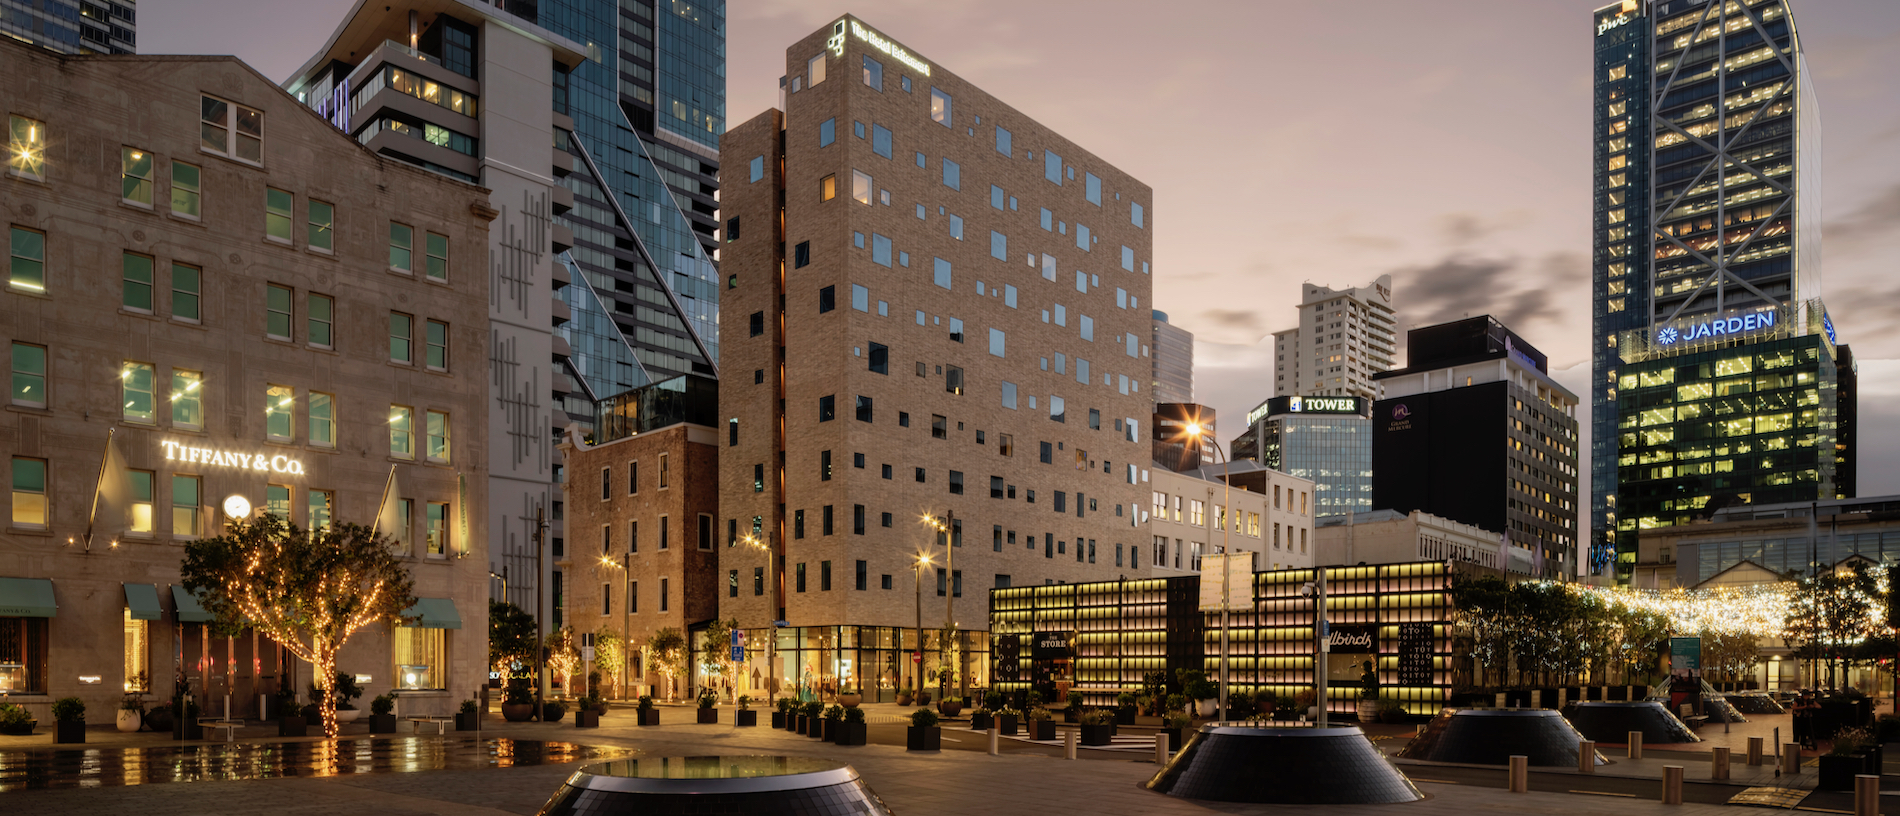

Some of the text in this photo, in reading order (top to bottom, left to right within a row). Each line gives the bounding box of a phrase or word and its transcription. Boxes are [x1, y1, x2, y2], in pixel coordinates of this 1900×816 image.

[1597, 16, 1628, 36] pwc
[851, 20, 931, 77] The Hotel Britomart
[1683, 311, 1774, 341] JARDEN
[1251, 403, 1268, 423] TOWER
[1305, 398, 1355, 411] TOWER
[162, 440, 252, 469] TIFFANY
[1040, 640, 1067, 648] STORE
[1328, 630, 1372, 649] llbirds
